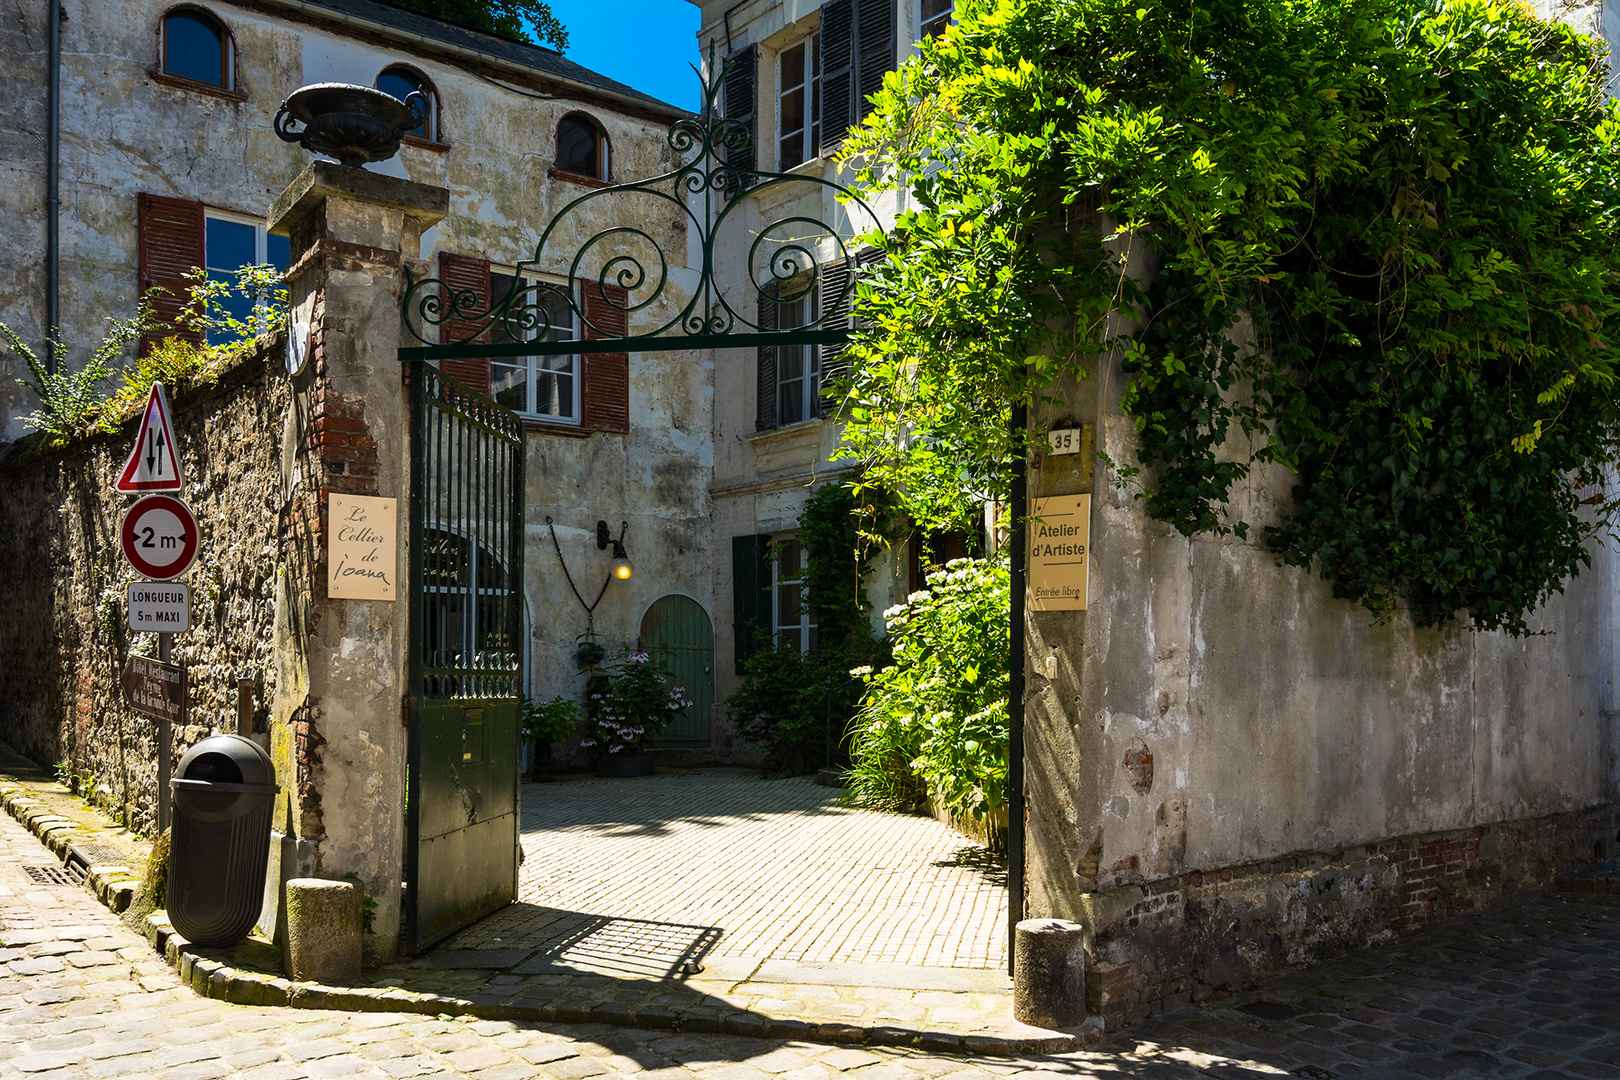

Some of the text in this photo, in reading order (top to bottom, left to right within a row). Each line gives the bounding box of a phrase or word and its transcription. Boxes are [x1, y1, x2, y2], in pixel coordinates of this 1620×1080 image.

[1055, 434, 1071, 449] 35
[344, 505, 367, 522] Le
[142, 527, 176, 548] 2 m
[338, 525, 384, 543] Cellier
[1039, 524, 1080, 537] Atelier
[361, 548, 379, 562] de
[1032, 543, 1085, 557] d'Artiste
[132, 591, 184, 603] LONGUEUR
[1036, 586, 1080, 597] Entrée libre
[156, 611, 180, 622] MAXI
[132, 688, 139, 703] de
[141, 690, 146, 705] la
